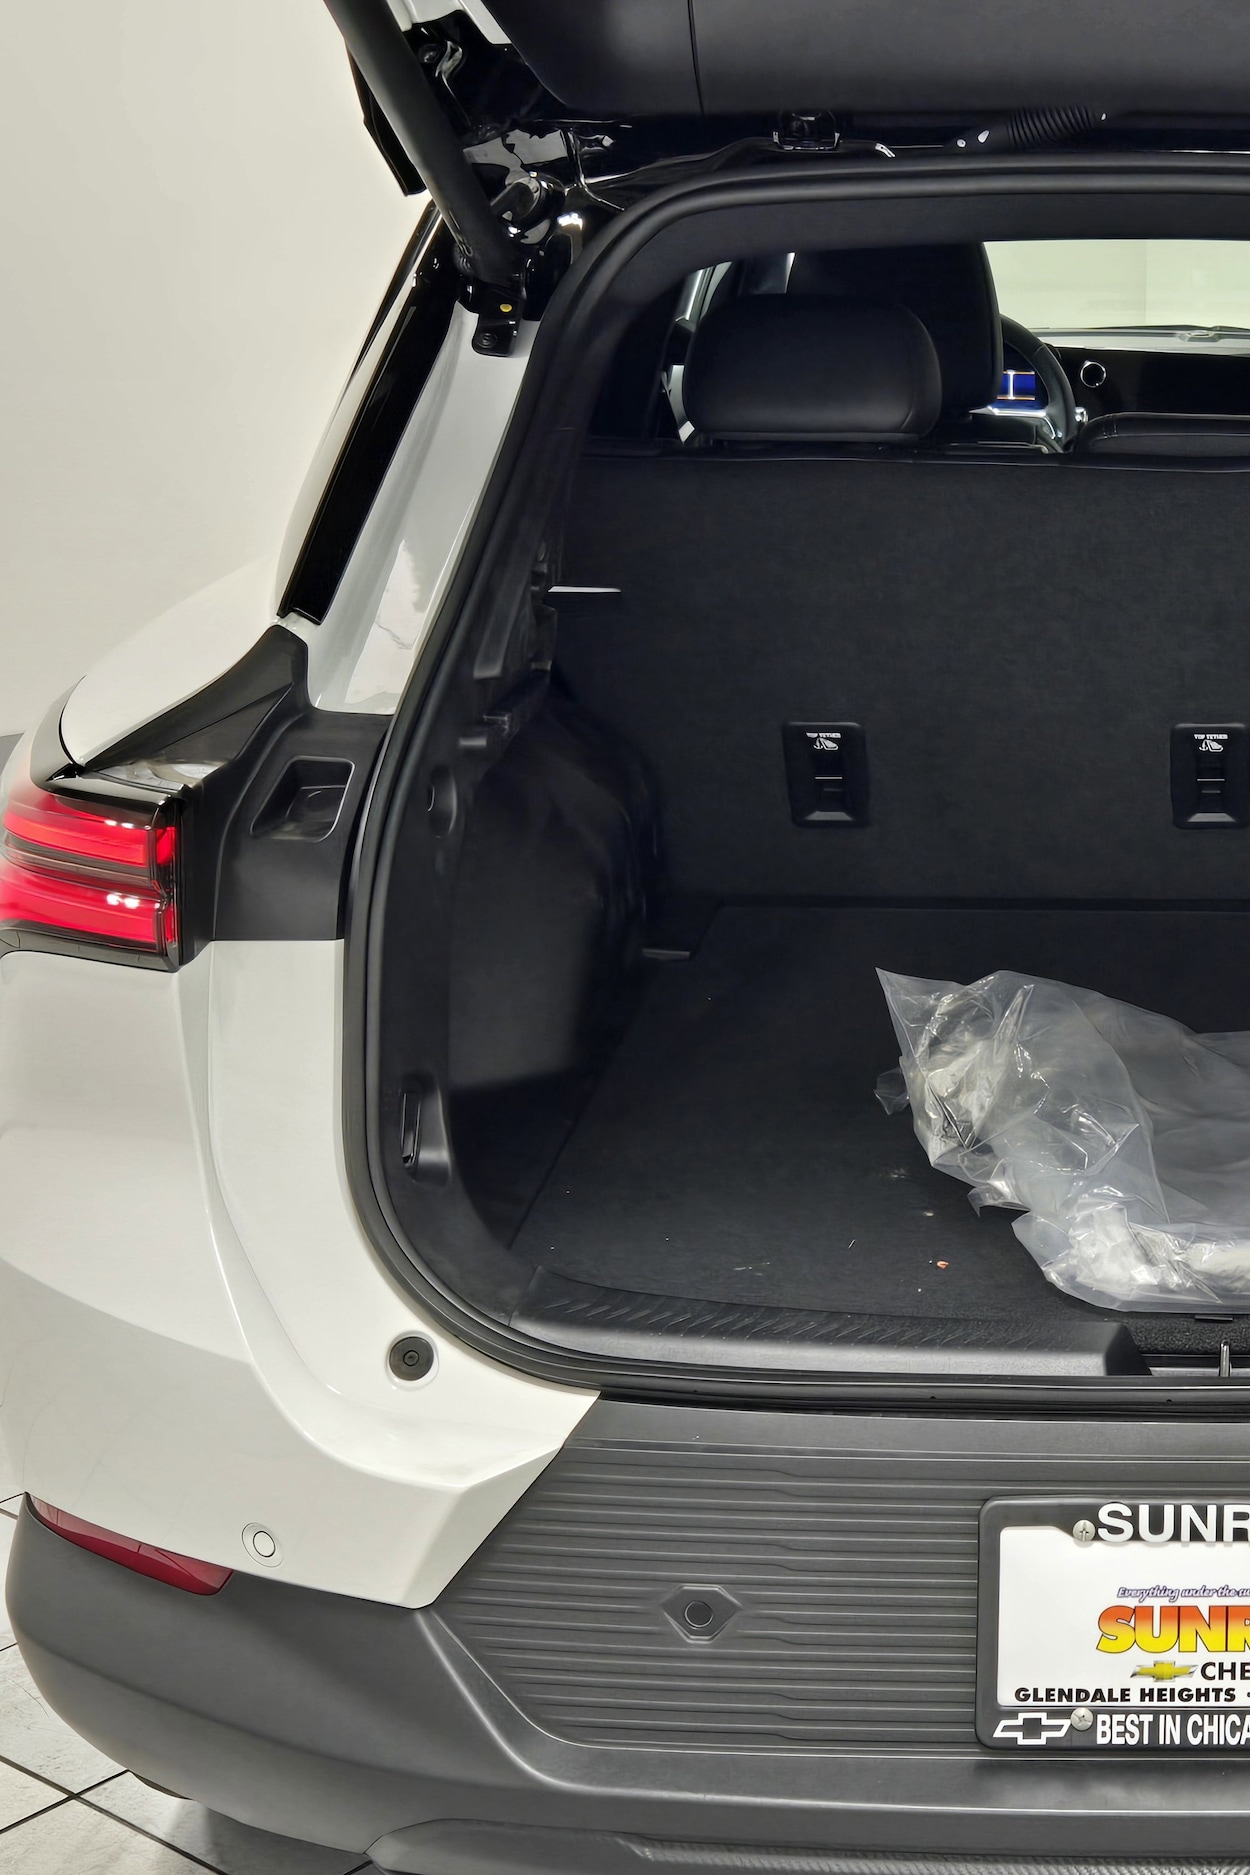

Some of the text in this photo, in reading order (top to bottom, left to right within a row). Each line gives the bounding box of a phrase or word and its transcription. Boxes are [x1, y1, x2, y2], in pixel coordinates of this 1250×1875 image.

[1117, 1585, 1179, 1603] Everything
[1181, 1585, 1217, 1597] under
[1217, 1585, 1239, 1597] the
[1014, 1687, 1131, 1703] GLENDALE
[1140, 1687, 1237, 1703] HEIGHTS
[1096, 1714, 1153, 1745] BEST
[1159, 1714, 1181, 1745] IN
